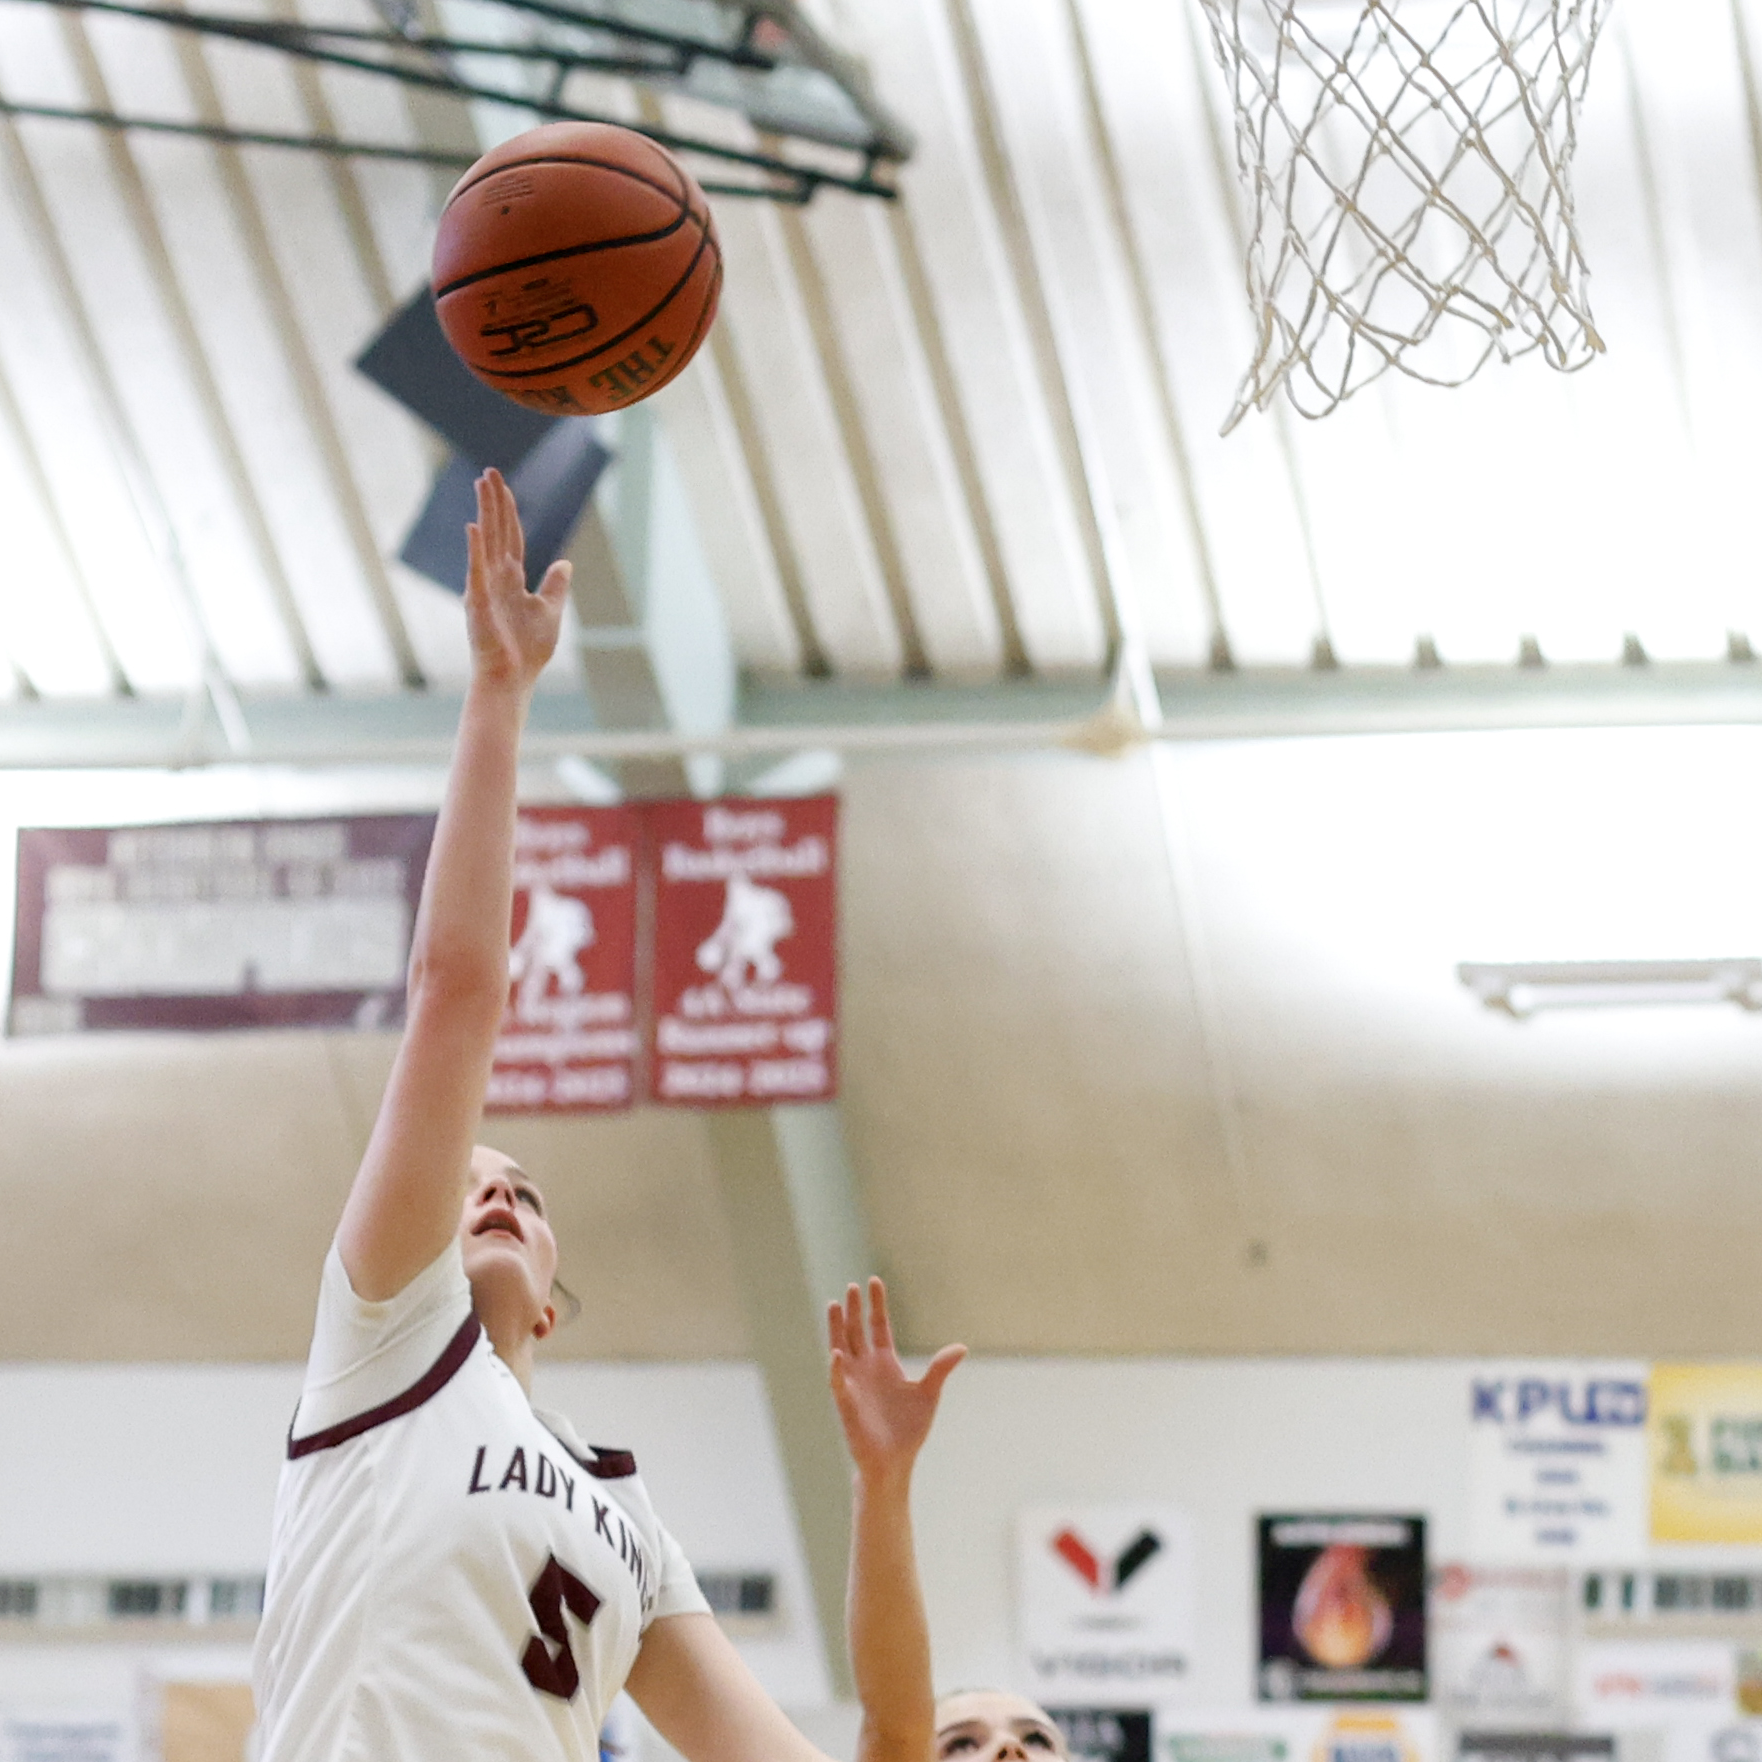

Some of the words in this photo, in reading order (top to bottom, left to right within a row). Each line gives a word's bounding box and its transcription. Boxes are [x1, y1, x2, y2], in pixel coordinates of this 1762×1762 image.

[468, 1445, 575, 1512] LADY
[591, 1494, 654, 1640] KING
[521, 1550, 604, 1705] 5
